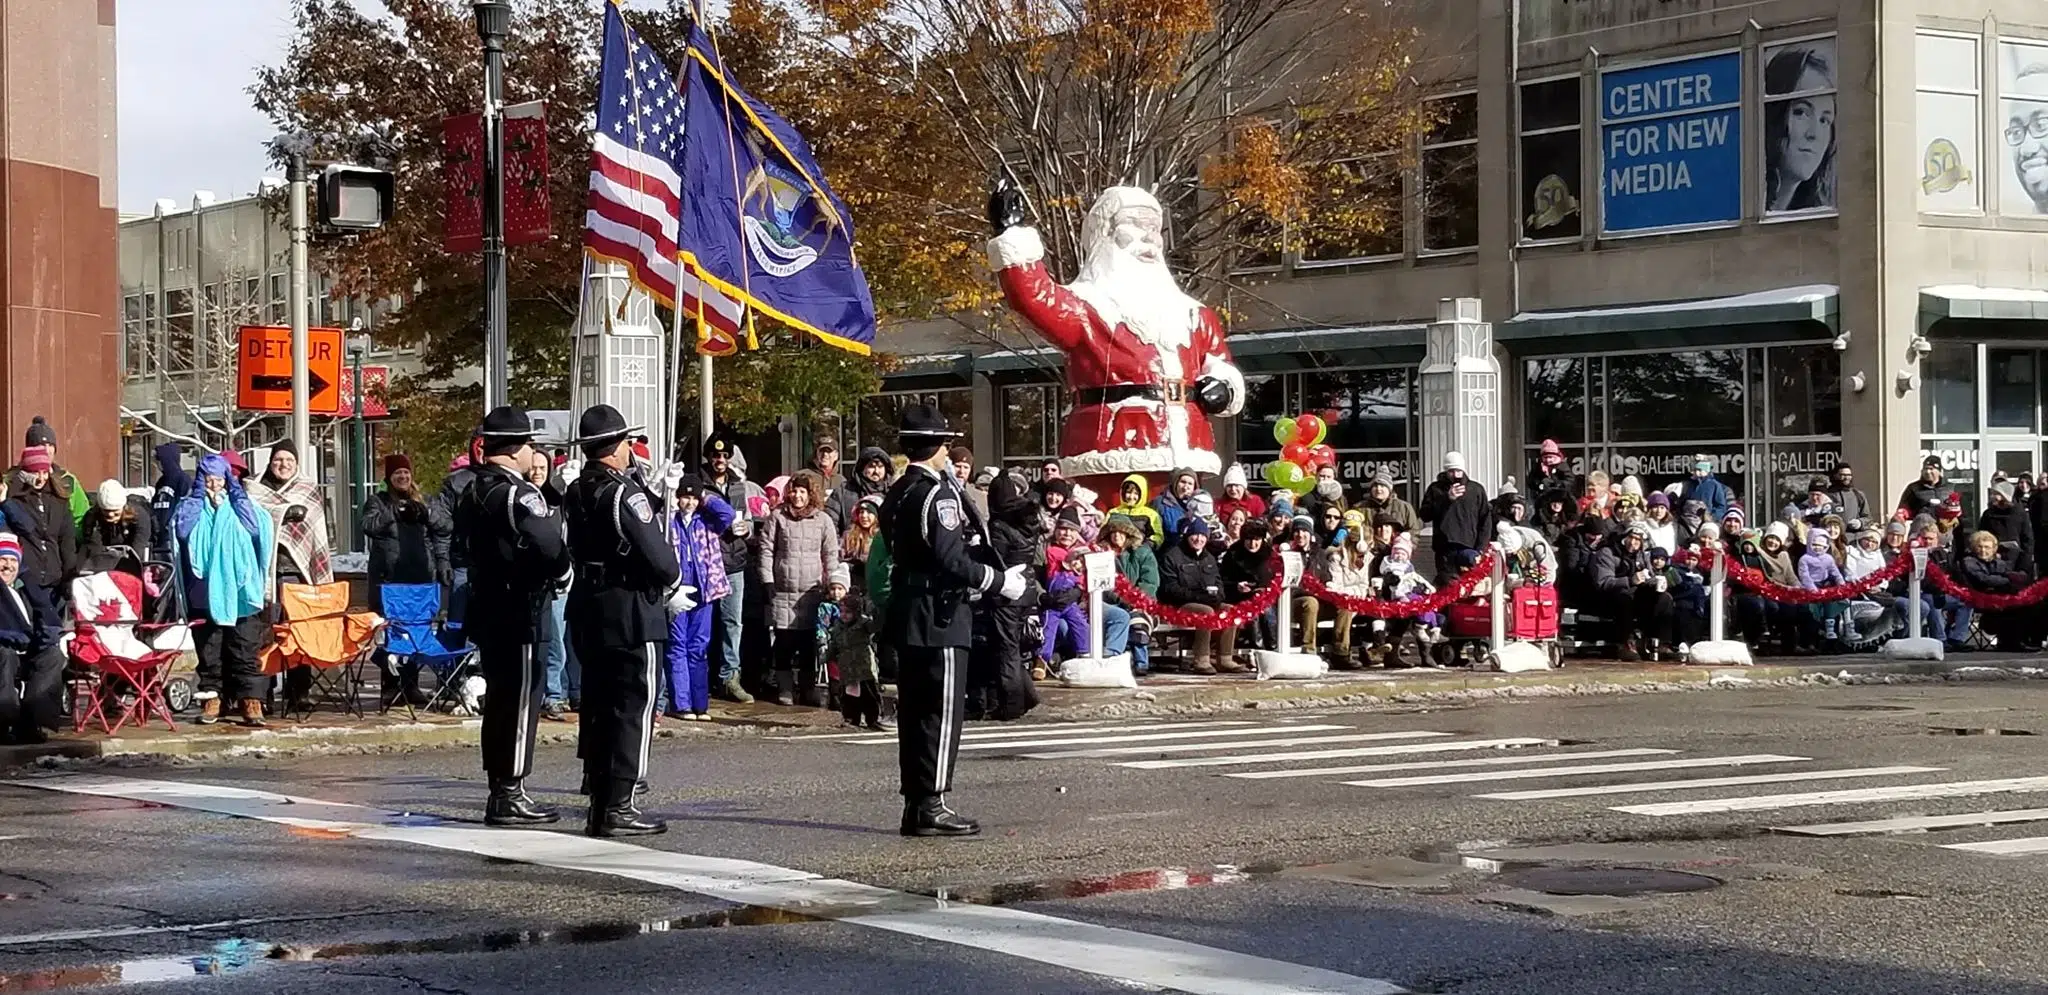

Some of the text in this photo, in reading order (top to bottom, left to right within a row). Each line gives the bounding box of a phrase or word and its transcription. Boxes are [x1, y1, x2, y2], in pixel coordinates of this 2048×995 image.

[1610, 74, 1712, 115] CENTER
[1610, 115, 1729, 159] FOR NEW
[1611, 160, 1693, 197] MEDIA
[1929, 151, 1957, 177] 50
[1540, 187, 1564, 209] 50
[248, 338, 331, 361] DETUR
